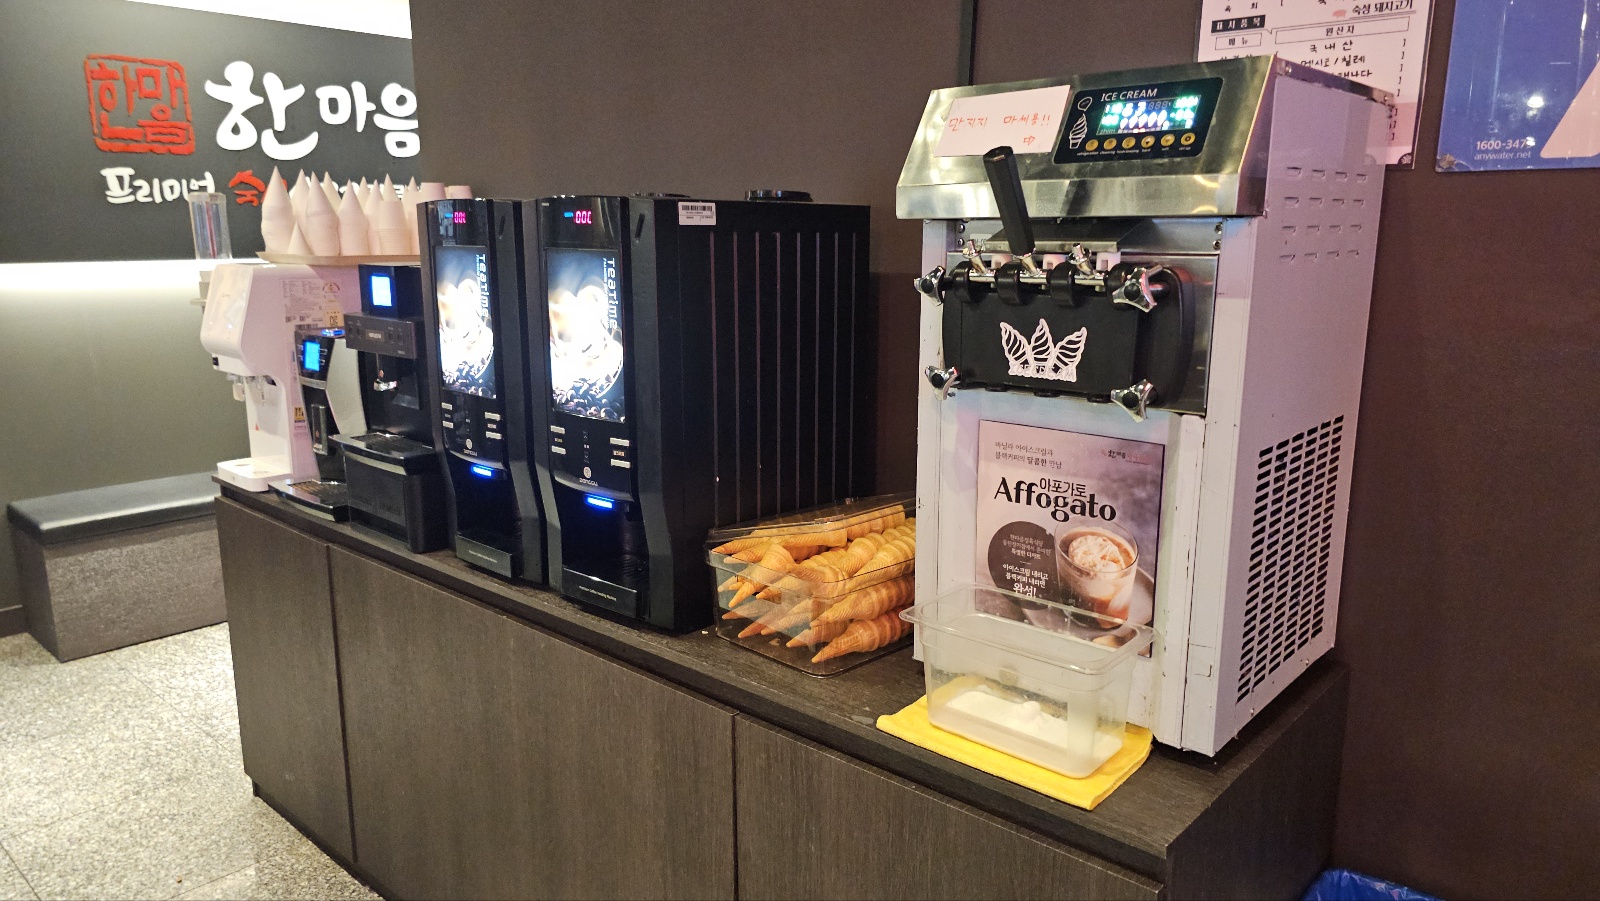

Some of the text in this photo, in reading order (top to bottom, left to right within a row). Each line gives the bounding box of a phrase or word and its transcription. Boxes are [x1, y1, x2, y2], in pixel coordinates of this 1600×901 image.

[1352, 0, 1413, 15] 숙성 돼지고기
[1100, 88, 1158, 102] ICE CREAM
[1476, 138, 1535, 151] 1600-347
[1474, 151, 1531, 161] anywater.net
[1039, 477, 1087, 498] 아포가토
[994, 476, 1117, 523] Affogato
[1002, 563, 1049, 580] 아이스크림 내리고
[1006, 572, 1028, 583] 블랙커피
[1012, 582, 1037, 599] 완성!
